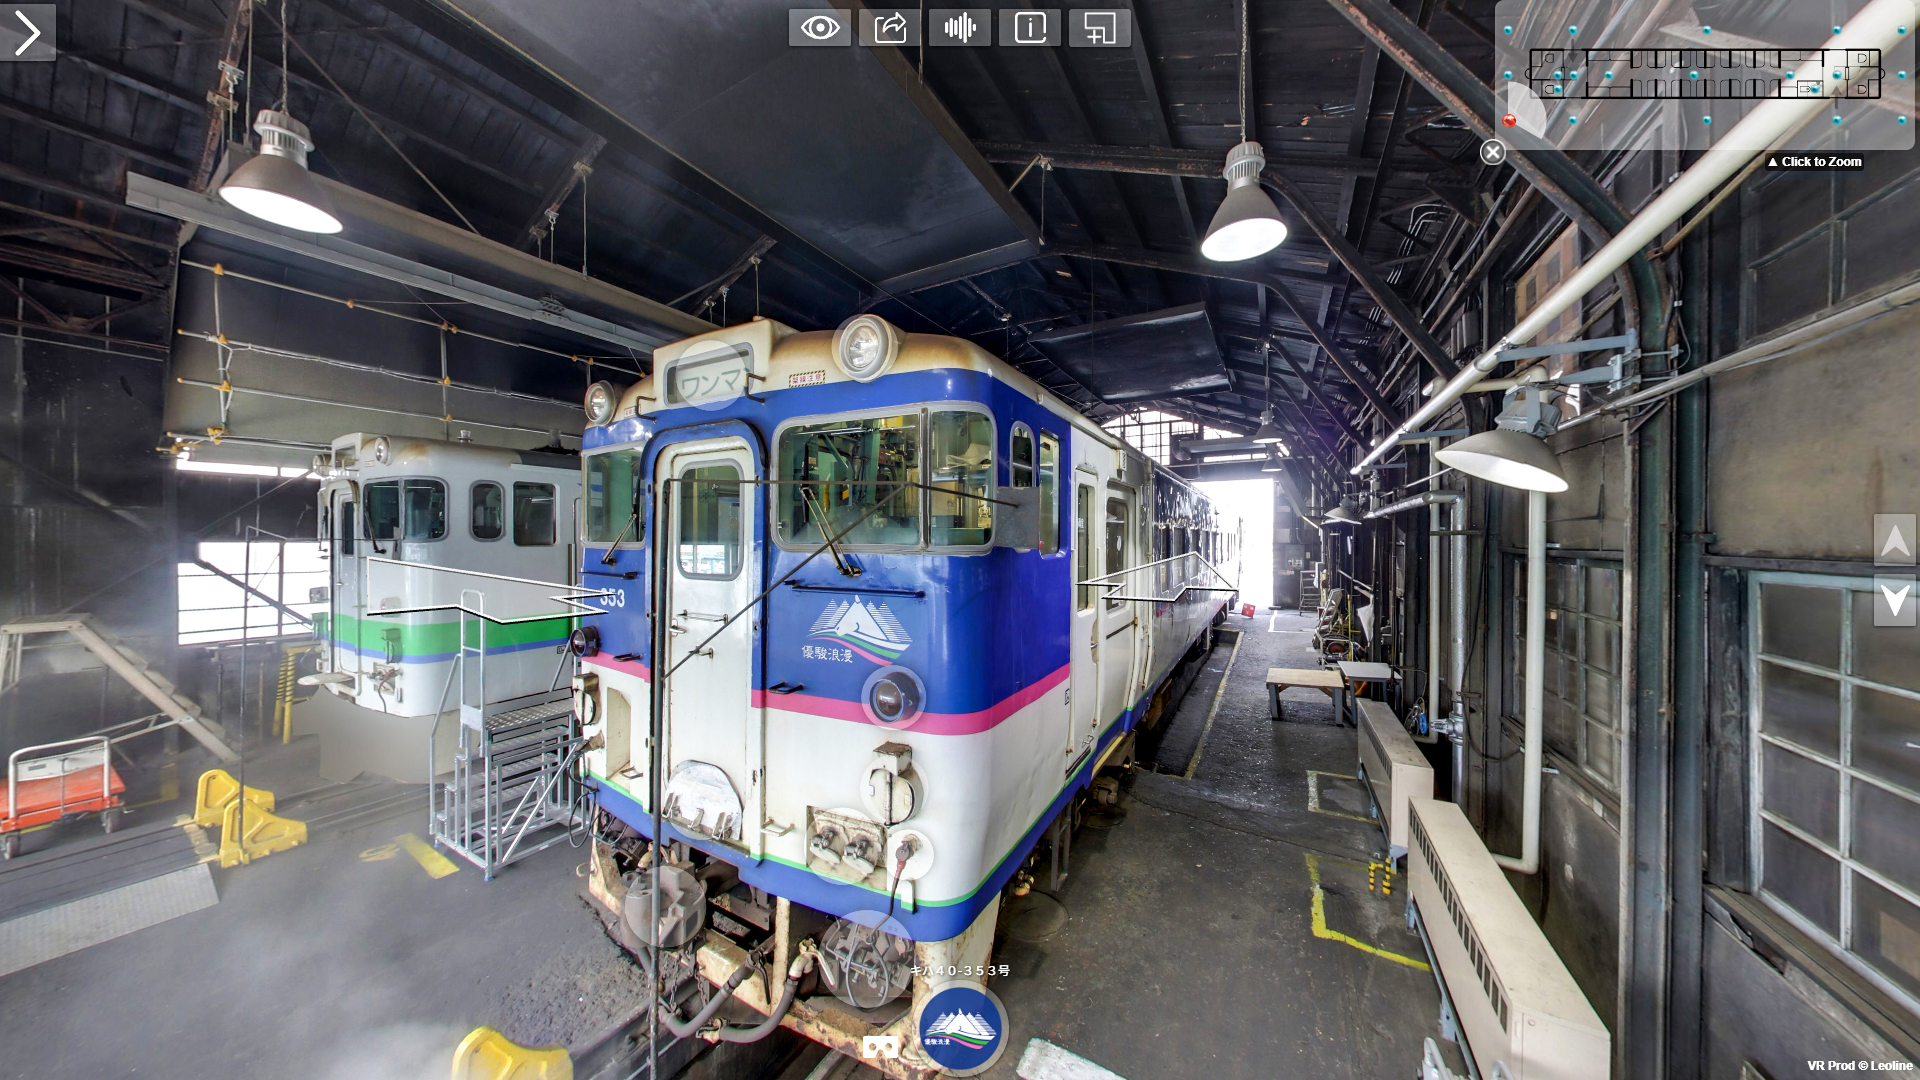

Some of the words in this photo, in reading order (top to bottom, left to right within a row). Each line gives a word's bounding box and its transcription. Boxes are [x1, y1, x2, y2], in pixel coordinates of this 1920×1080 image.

[600, 587, 626, 608] 353
[801, 644, 853, 663] 優駿浪漫
